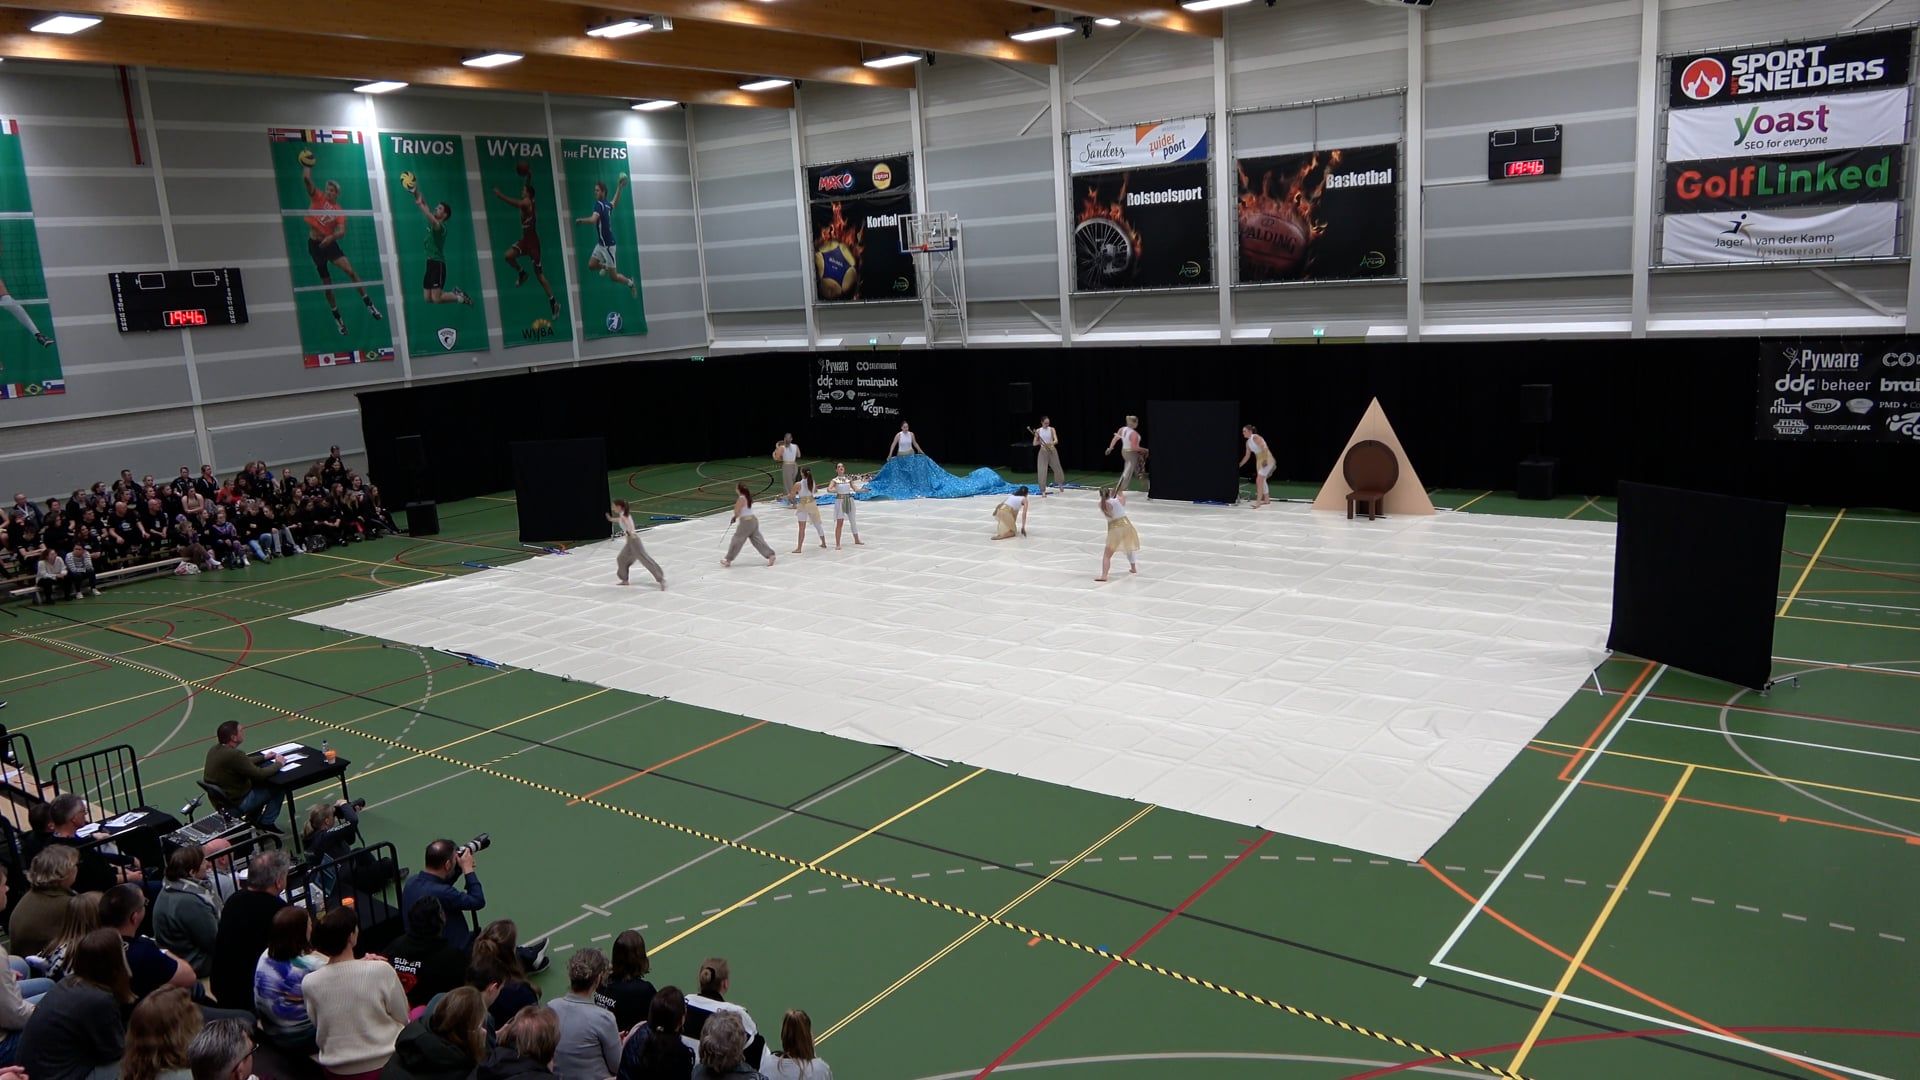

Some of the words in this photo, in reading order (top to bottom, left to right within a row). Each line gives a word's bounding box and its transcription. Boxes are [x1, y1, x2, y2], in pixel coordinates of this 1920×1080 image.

[1732, 46, 1826, 76] SPORT
[1738, 59, 1884, 94] SNELDERS
[391, 136, 454, 155] TRIVOS
[487, 139, 543, 158] WYBA
[1149, 133, 1175, 152] zuider
[1163, 139, 1186, 160] poort
[1744, 141, 1764, 150] SEO
[1767, 139, 1781, 148] for
[1783, 136, 1828, 148] everyone
[563, 150, 579, 158] THE
[580, 144, 627, 160] FLYERS
[1080, 141, 1126, 162] Sanders
[1509, 160, 1544, 176] 19:46
[819, 175, 844, 190] MAX
[1326, 168, 1392, 189] Basketbal
[1676, 155, 1890, 200] GolfLinked
[1127, 186, 1203, 206] Rolstoelsport
[867, 214, 897, 228] Korfbal
[1715, 238, 1744, 249] Jager
[1755, 237, 1776, 246] van
[1778, 234, 1797, 244] der
[1800, 233, 1835, 245] Kamp
[169, 310, 204, 325] 19:46
[826, 360, 849, 373] Pyware
[1801, 349, 1860, 371] Pyware
[817, 375, 833, 389] ddf
[857, 377, 898, 388] brainpink
[1775, 374, 1815, 395] ddf
[1821, 379, 1872, 391] beheer
[868, 405, 884, 416] cgn
[1879, 401, 1900, 409] PMD
